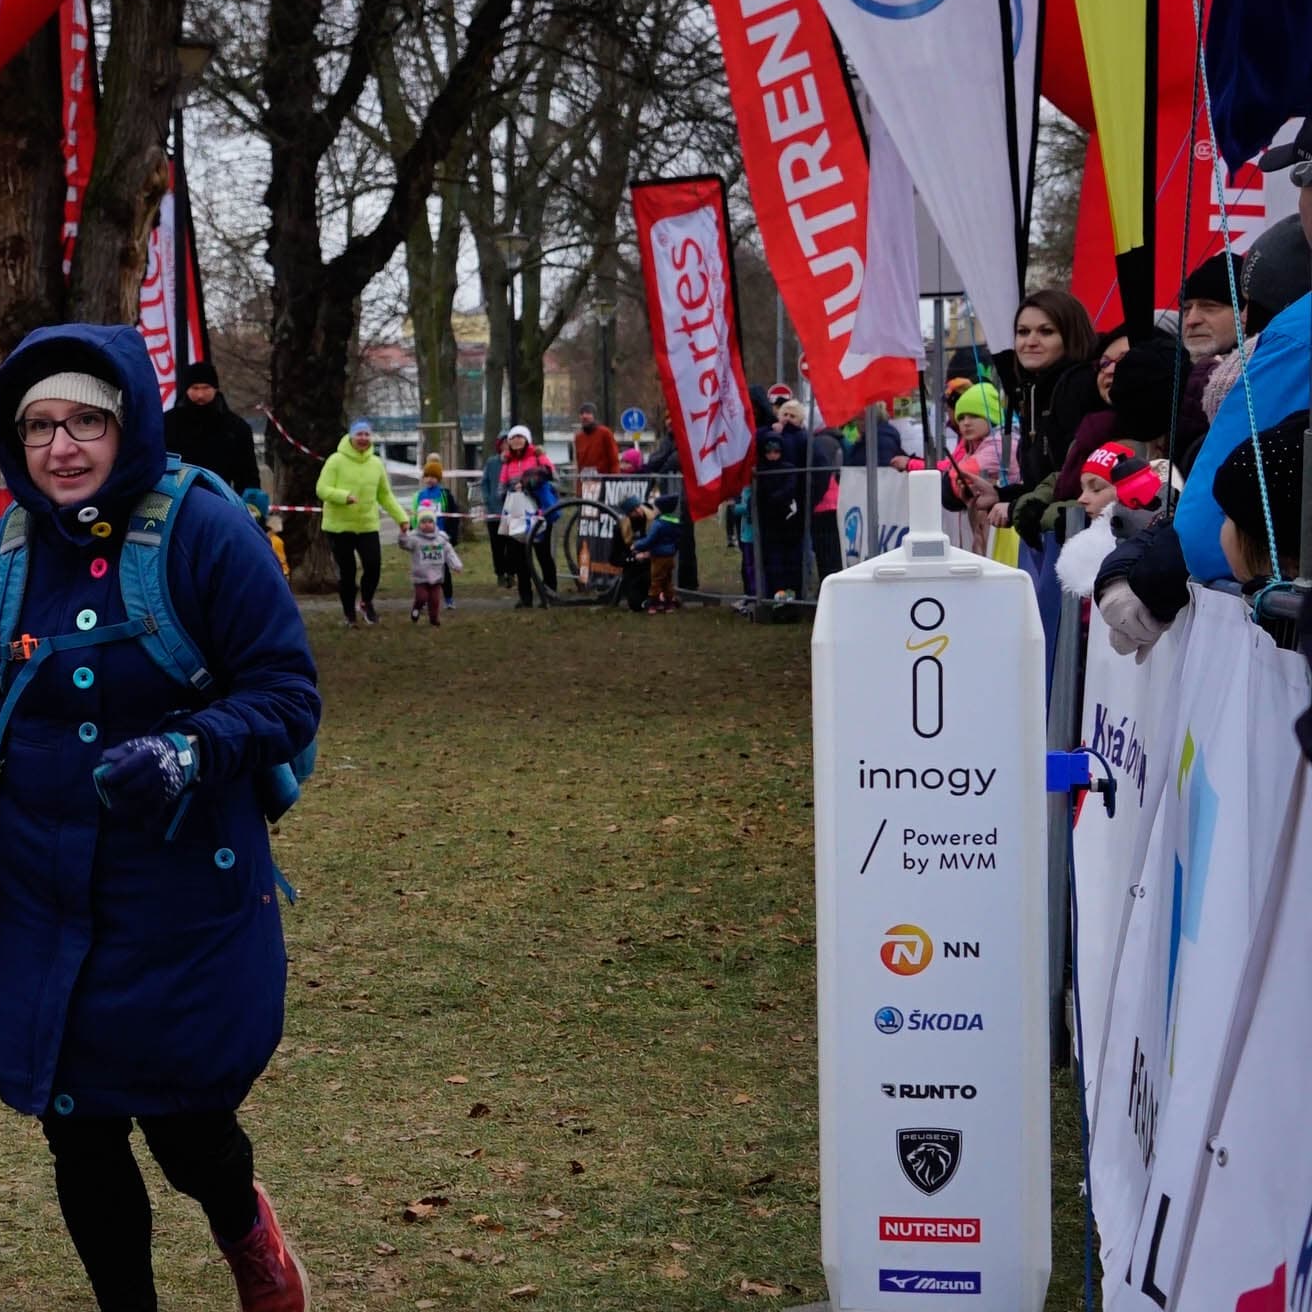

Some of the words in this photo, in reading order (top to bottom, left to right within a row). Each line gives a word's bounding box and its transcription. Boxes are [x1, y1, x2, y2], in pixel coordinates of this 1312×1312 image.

[858, 759, 997, 796] innogy
[903, 827, 998, 846] Powered
[903, 852, 929, 875] by
[939, 852, 996, 870] MVM
[943, 941, 980, 958] NN
[907, 1009, 984, 1031] ŠKODA
[899, 1084, 977, 1100] RUNTO
[902, 1133, 956, 1141] PEUGEOT
[885, 1221, 976, 1237] NUTREND
